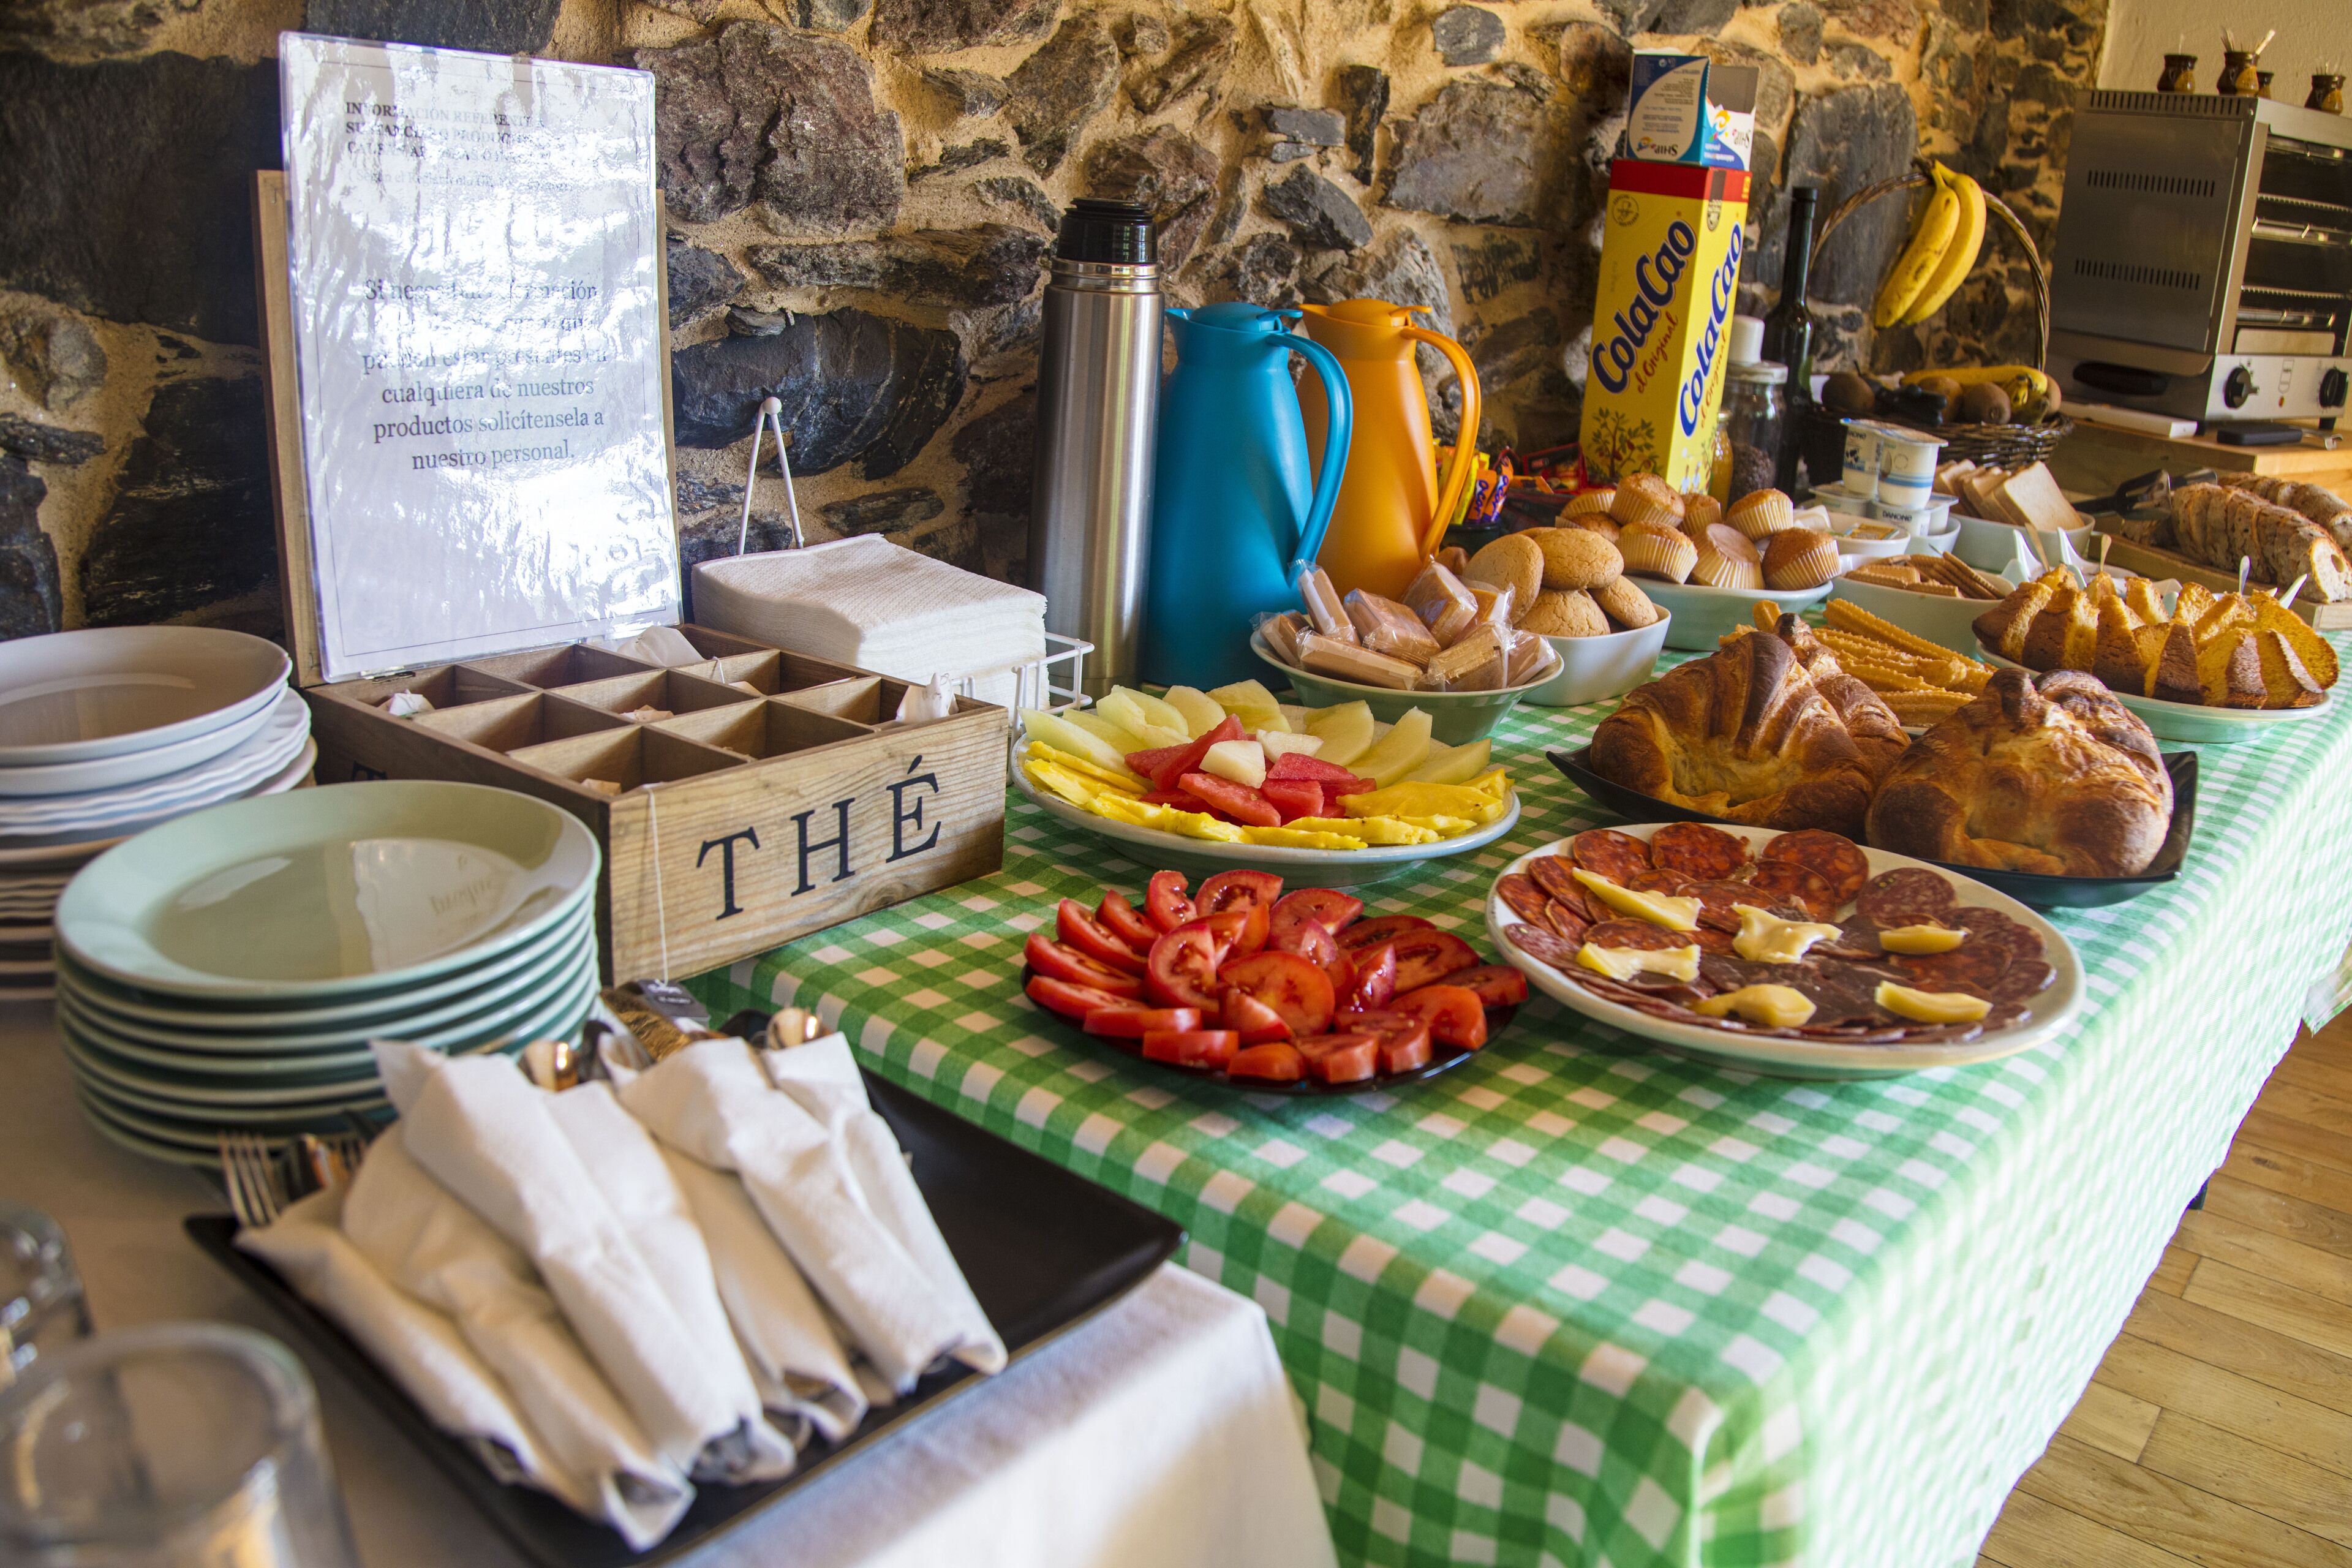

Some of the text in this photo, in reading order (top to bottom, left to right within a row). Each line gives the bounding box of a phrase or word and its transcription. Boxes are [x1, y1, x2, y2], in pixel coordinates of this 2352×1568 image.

[1593, 220, 1696, 394] ColaCao
[1679, 221, 1742, 438] ColaCao
[373, 407, 605, 443] productos solicítensela a
[382, 380, 484, 406] cualquiera
[517, 378, 595, 398] nuestros
[412, 439, 576, 470] nuestro personal.
[695, 754, 942, 921] THÉ
